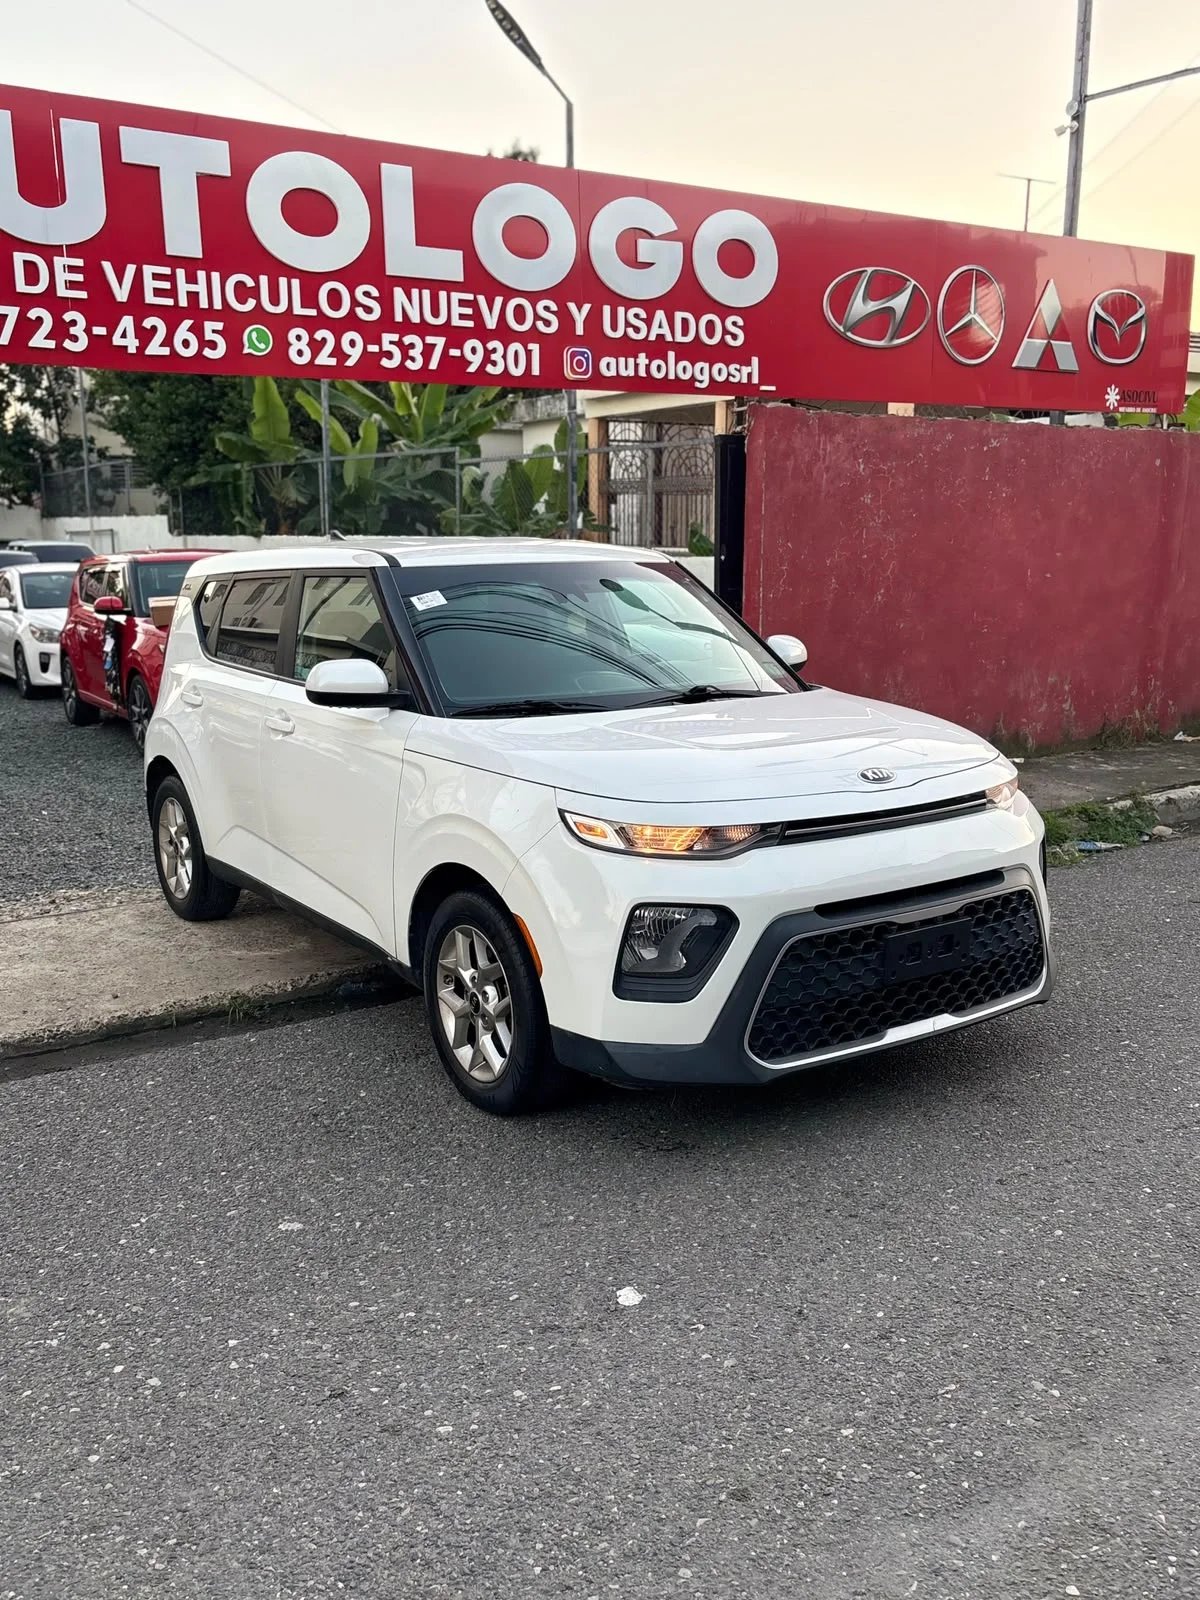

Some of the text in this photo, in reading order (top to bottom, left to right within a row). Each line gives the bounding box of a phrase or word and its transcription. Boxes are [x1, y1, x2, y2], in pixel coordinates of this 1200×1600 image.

[13, 252, 745, 347] DE VEHICULOS NUEVOS Y USADOS
[287, 328, 540, 376] 829-537-9301
